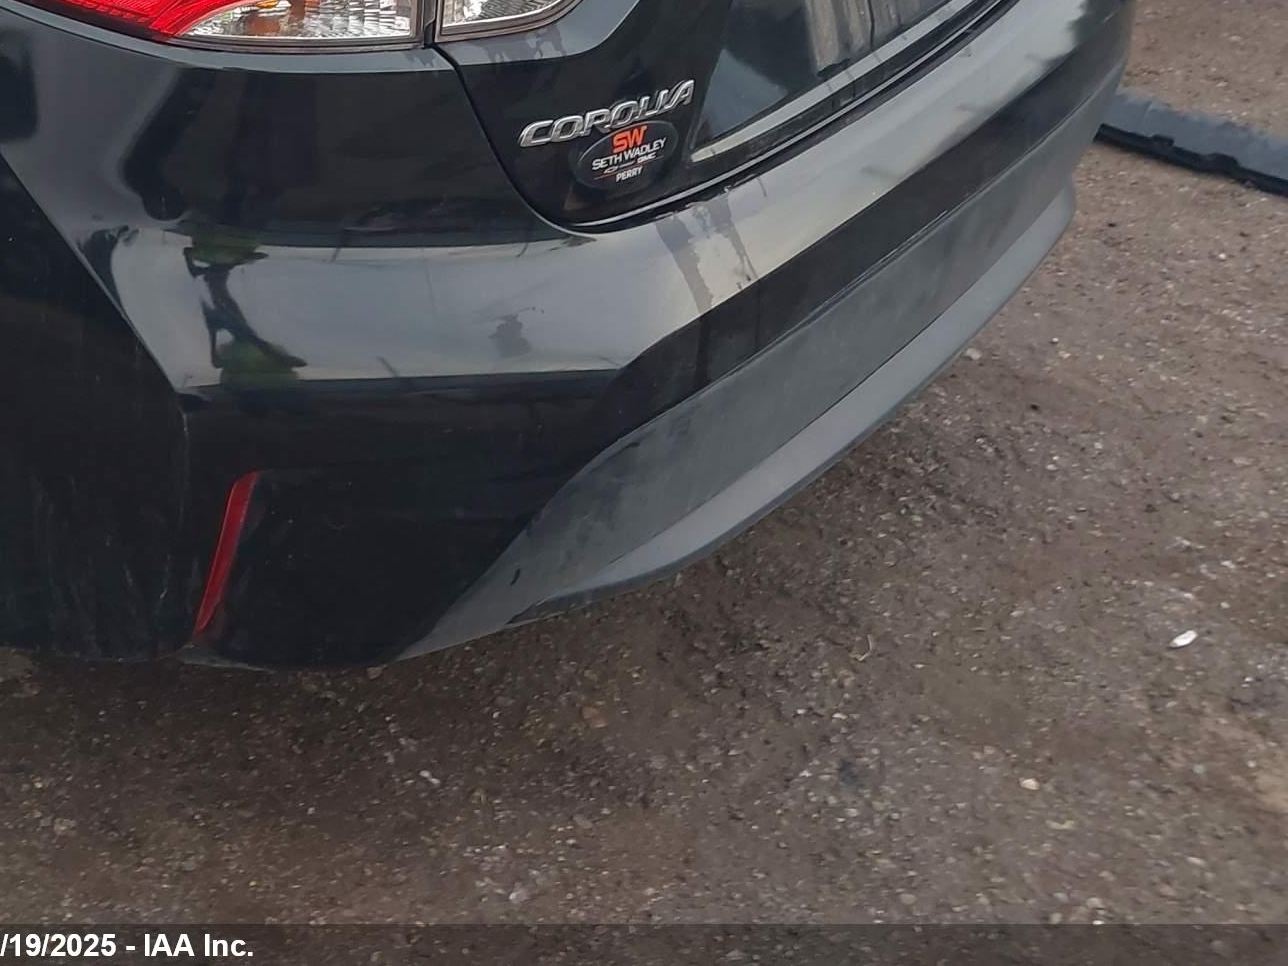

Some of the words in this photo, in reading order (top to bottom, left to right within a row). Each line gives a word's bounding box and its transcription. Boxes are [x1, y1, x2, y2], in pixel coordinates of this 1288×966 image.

[518, 79, 695, 147] COROLLA
[591, 152, 623, 171] SETH
[623, 136, 667, 162] WADLEY
[612, 124, 648, 154] SW
[615, 164, 644, 183] PERRY
